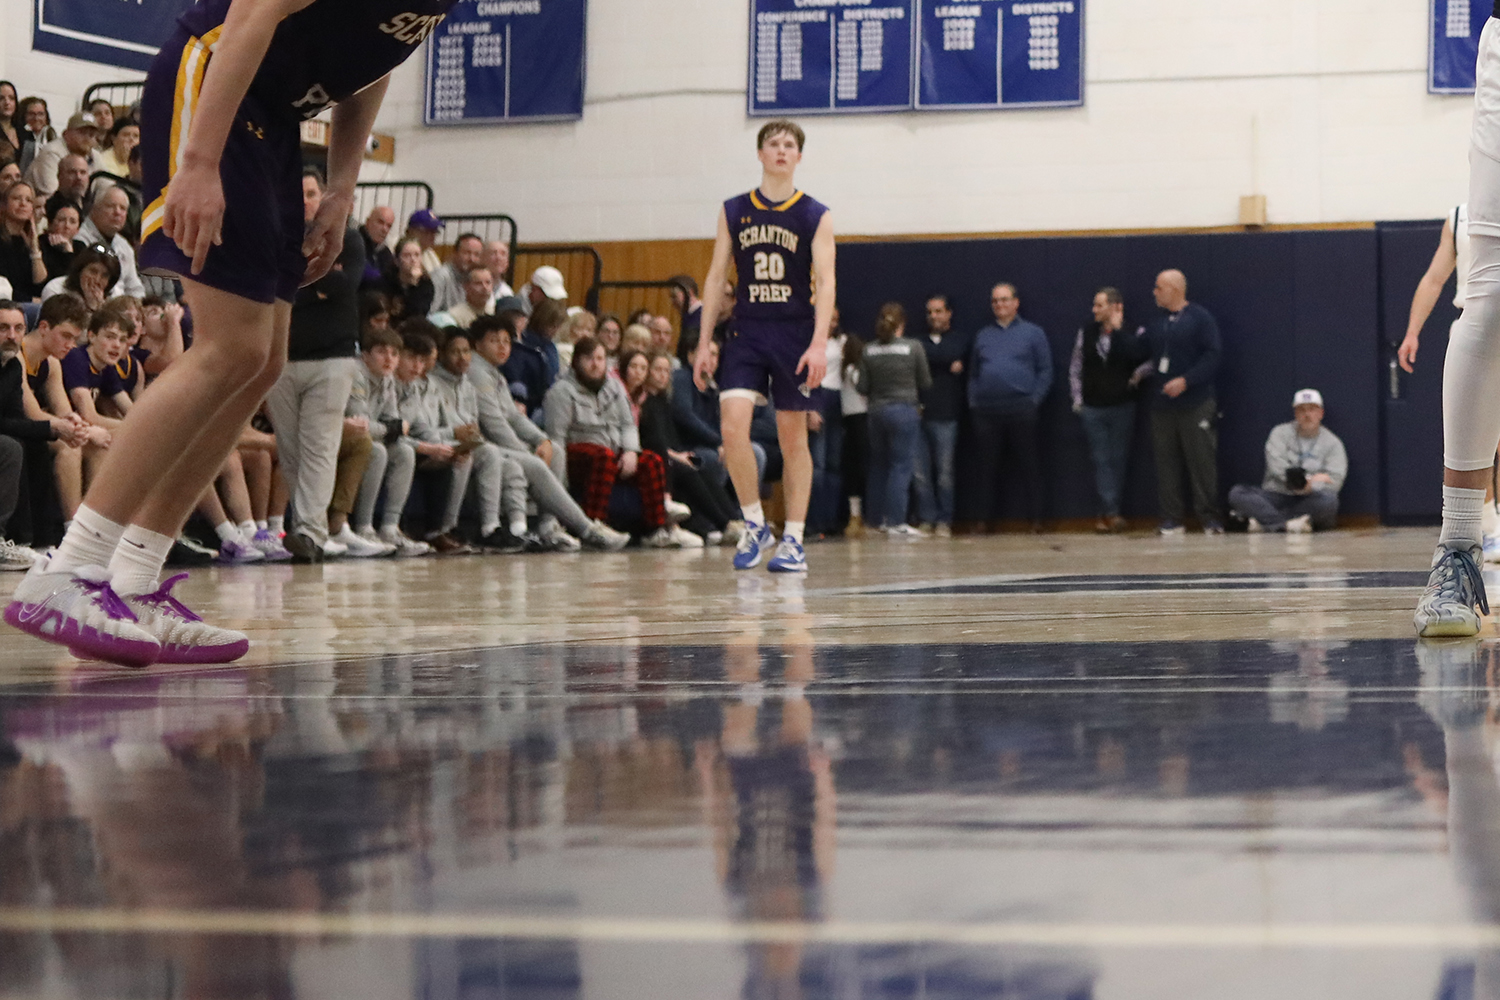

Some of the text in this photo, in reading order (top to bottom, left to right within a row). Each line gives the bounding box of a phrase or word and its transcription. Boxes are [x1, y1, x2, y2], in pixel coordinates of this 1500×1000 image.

[477, 0, 541, 17] CHAMPIONS
[757, 6, 905, 23] CONFERENCE DISTRICTS
[935, 1, 1074, 18] LEAGUE DISTRICTS
[447, 21, 491, 35] LEAGUE
[738, 224, 800, 254] SCRANTON
[753, 251, 785, 281] 20
[748, 284, 792, 303] PREP
